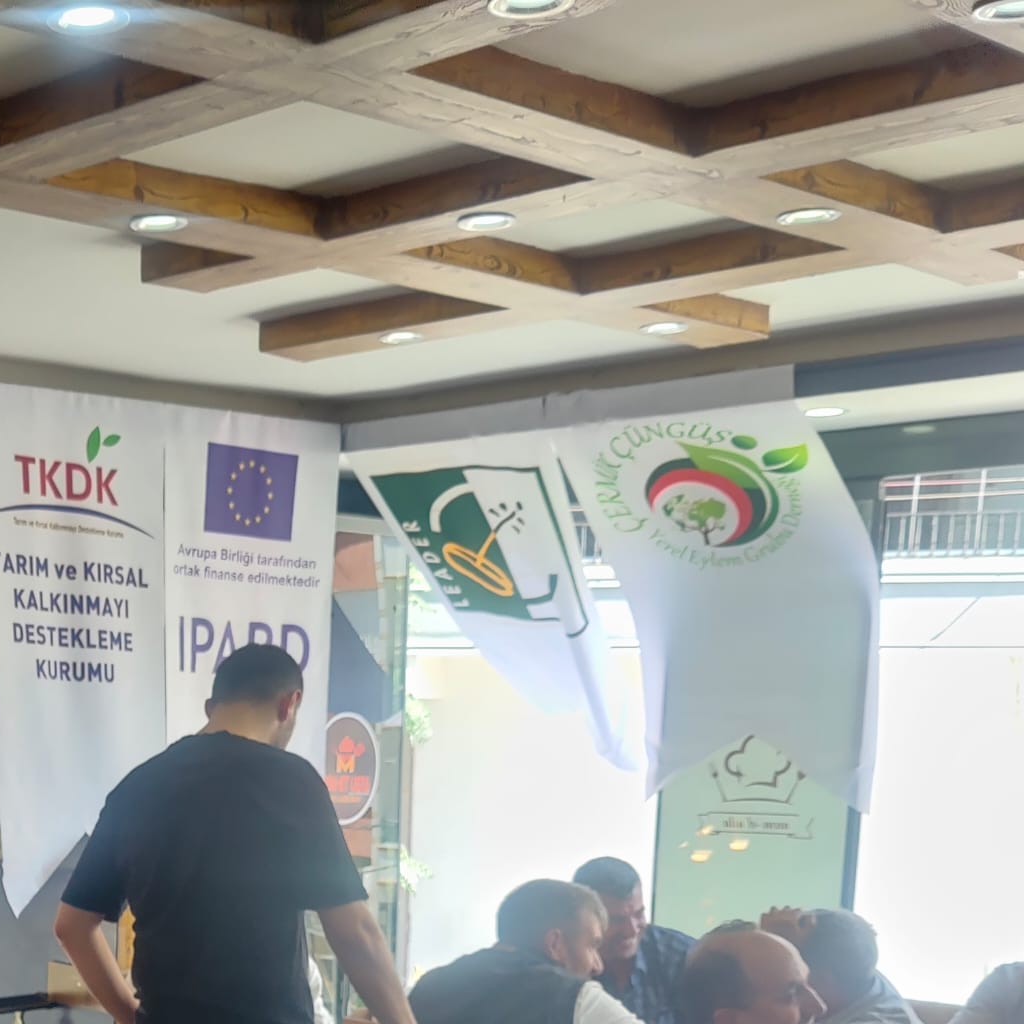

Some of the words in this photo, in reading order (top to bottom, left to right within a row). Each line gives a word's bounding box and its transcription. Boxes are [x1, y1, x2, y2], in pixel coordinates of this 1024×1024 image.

[609, 420, 733, 461] ÇÜNGÜŞ
[14, 454, 118, 507] TKDK
[177, 543, 218, 561] Avrupa
[220, 548, 254, 567] Birliği
[257, 553, 317, 570] tarafından
[402, 519, 471, 608] LEADER
[54, 563, 78, 580] ve
[83, 561, 149, 588] KIRSAL
[173, 564, 200, 578] ortak
[203, 566, 245, 583] finanse
[247, 571, 320, 588] edilmektedir
[13, 587, 129, 619] KALKINMAYI
[12, 622, 133, 652] DESTEKLEME
[35, 658, 115, 683] KURUMU
